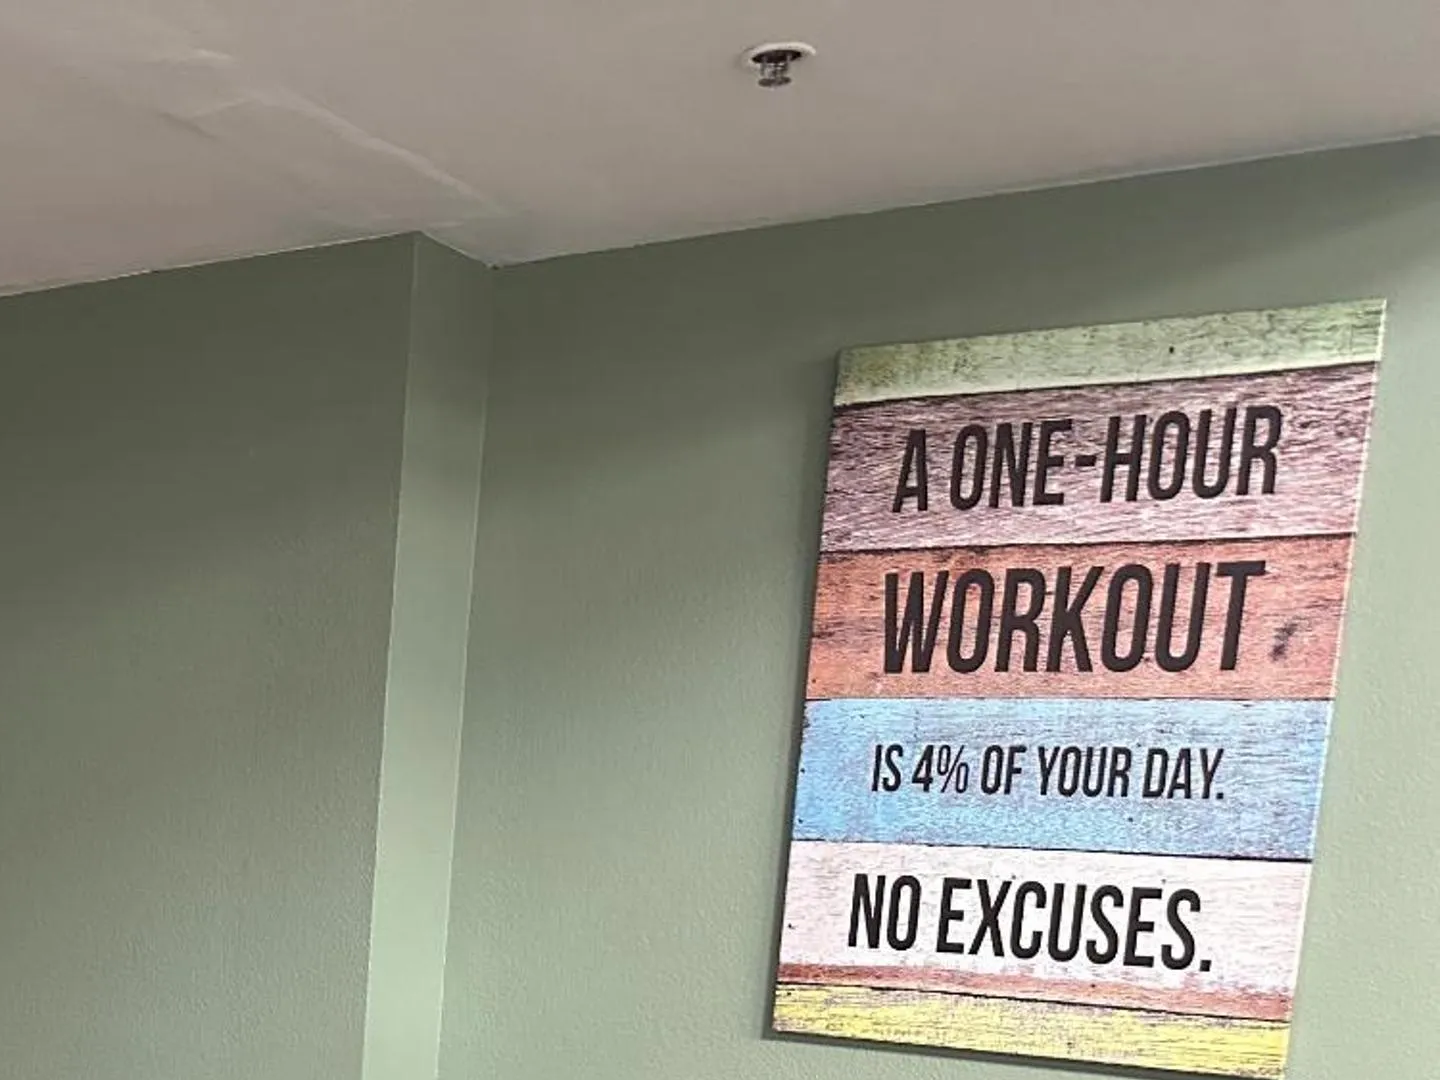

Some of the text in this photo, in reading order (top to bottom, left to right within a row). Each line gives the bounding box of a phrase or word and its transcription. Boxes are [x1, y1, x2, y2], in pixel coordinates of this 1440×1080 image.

[891, 405, 1284, 513] A ONE-HOUR
[882, 559, 1267, 674] WORKOUT
[871, 744, 1226, 800] IS 4% OF YOUR DAY.
[848, 873, 1213, 972] NO EXCUSES.
